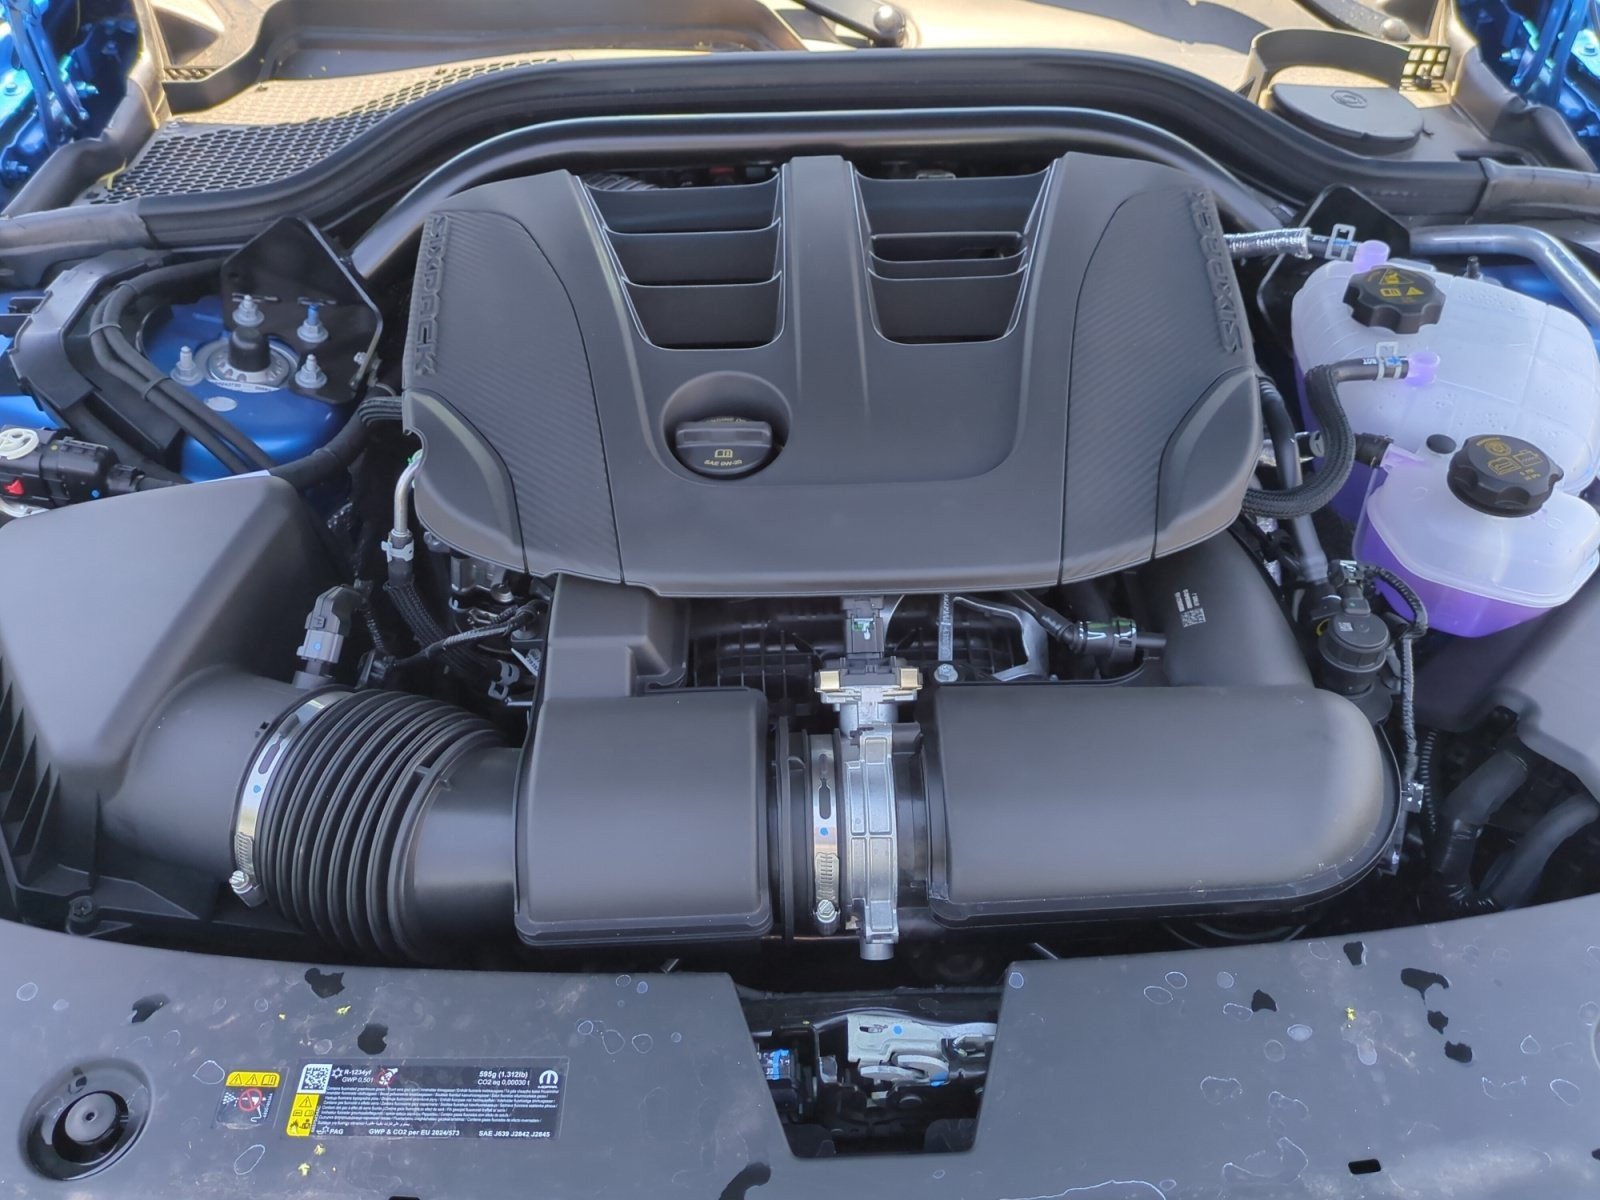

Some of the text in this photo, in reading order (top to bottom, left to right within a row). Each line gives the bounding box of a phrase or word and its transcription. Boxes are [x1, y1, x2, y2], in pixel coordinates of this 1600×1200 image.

[413, 215, 449, 376] SIXPACK
[1191, 191, 1244, 353] SIXPACK
[343, 1069, 372, 1077] R-1234yf
[479, 1070, 529, 1080] 595g (1.312lb)
